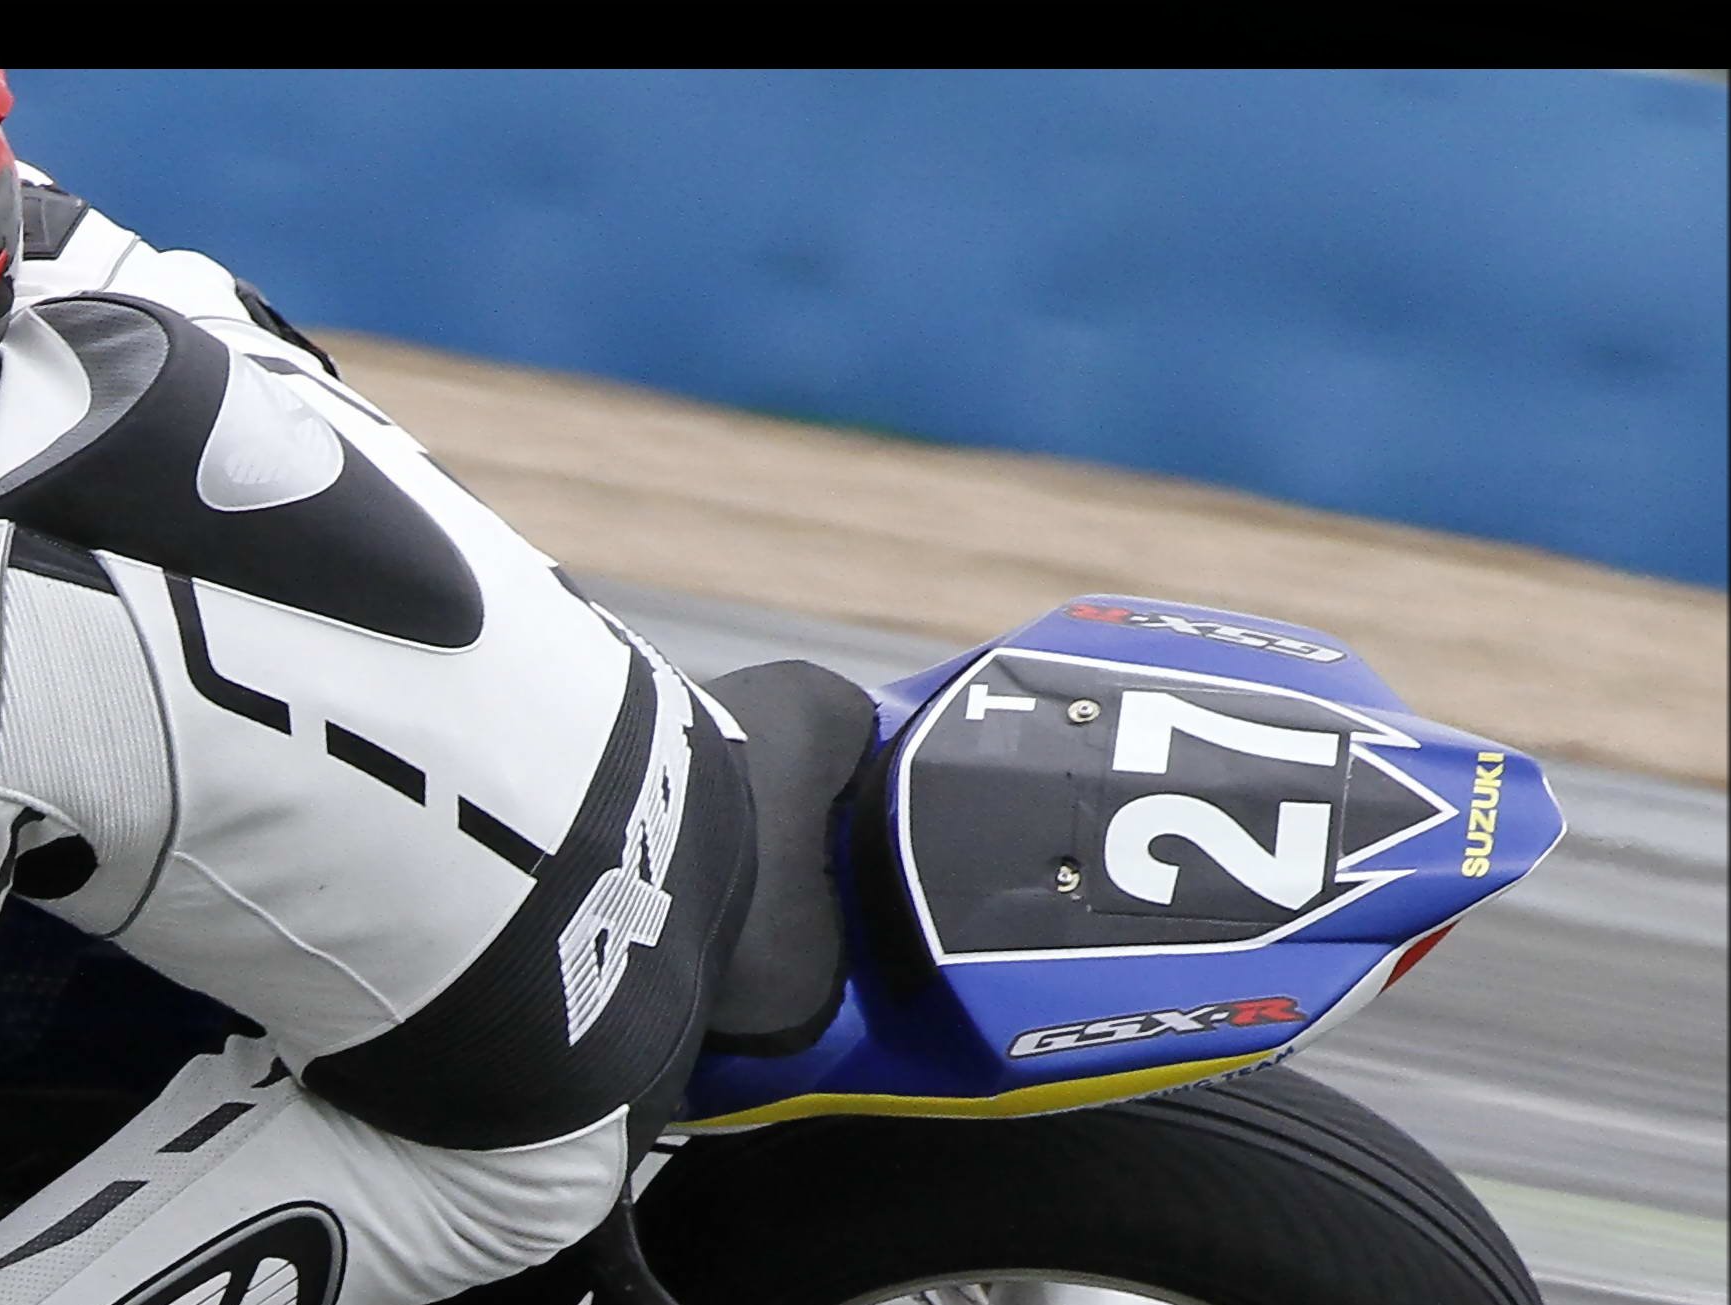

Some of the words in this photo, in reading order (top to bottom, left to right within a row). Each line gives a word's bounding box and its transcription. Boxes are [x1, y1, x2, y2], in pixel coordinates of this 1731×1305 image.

[964, 683, 1037, 722] T
[1103, 690, 1341, 912] 27
[1460, 750, 1507, 880] SUZUKI
[1007, 996, 1308, 1059] GSX-R
